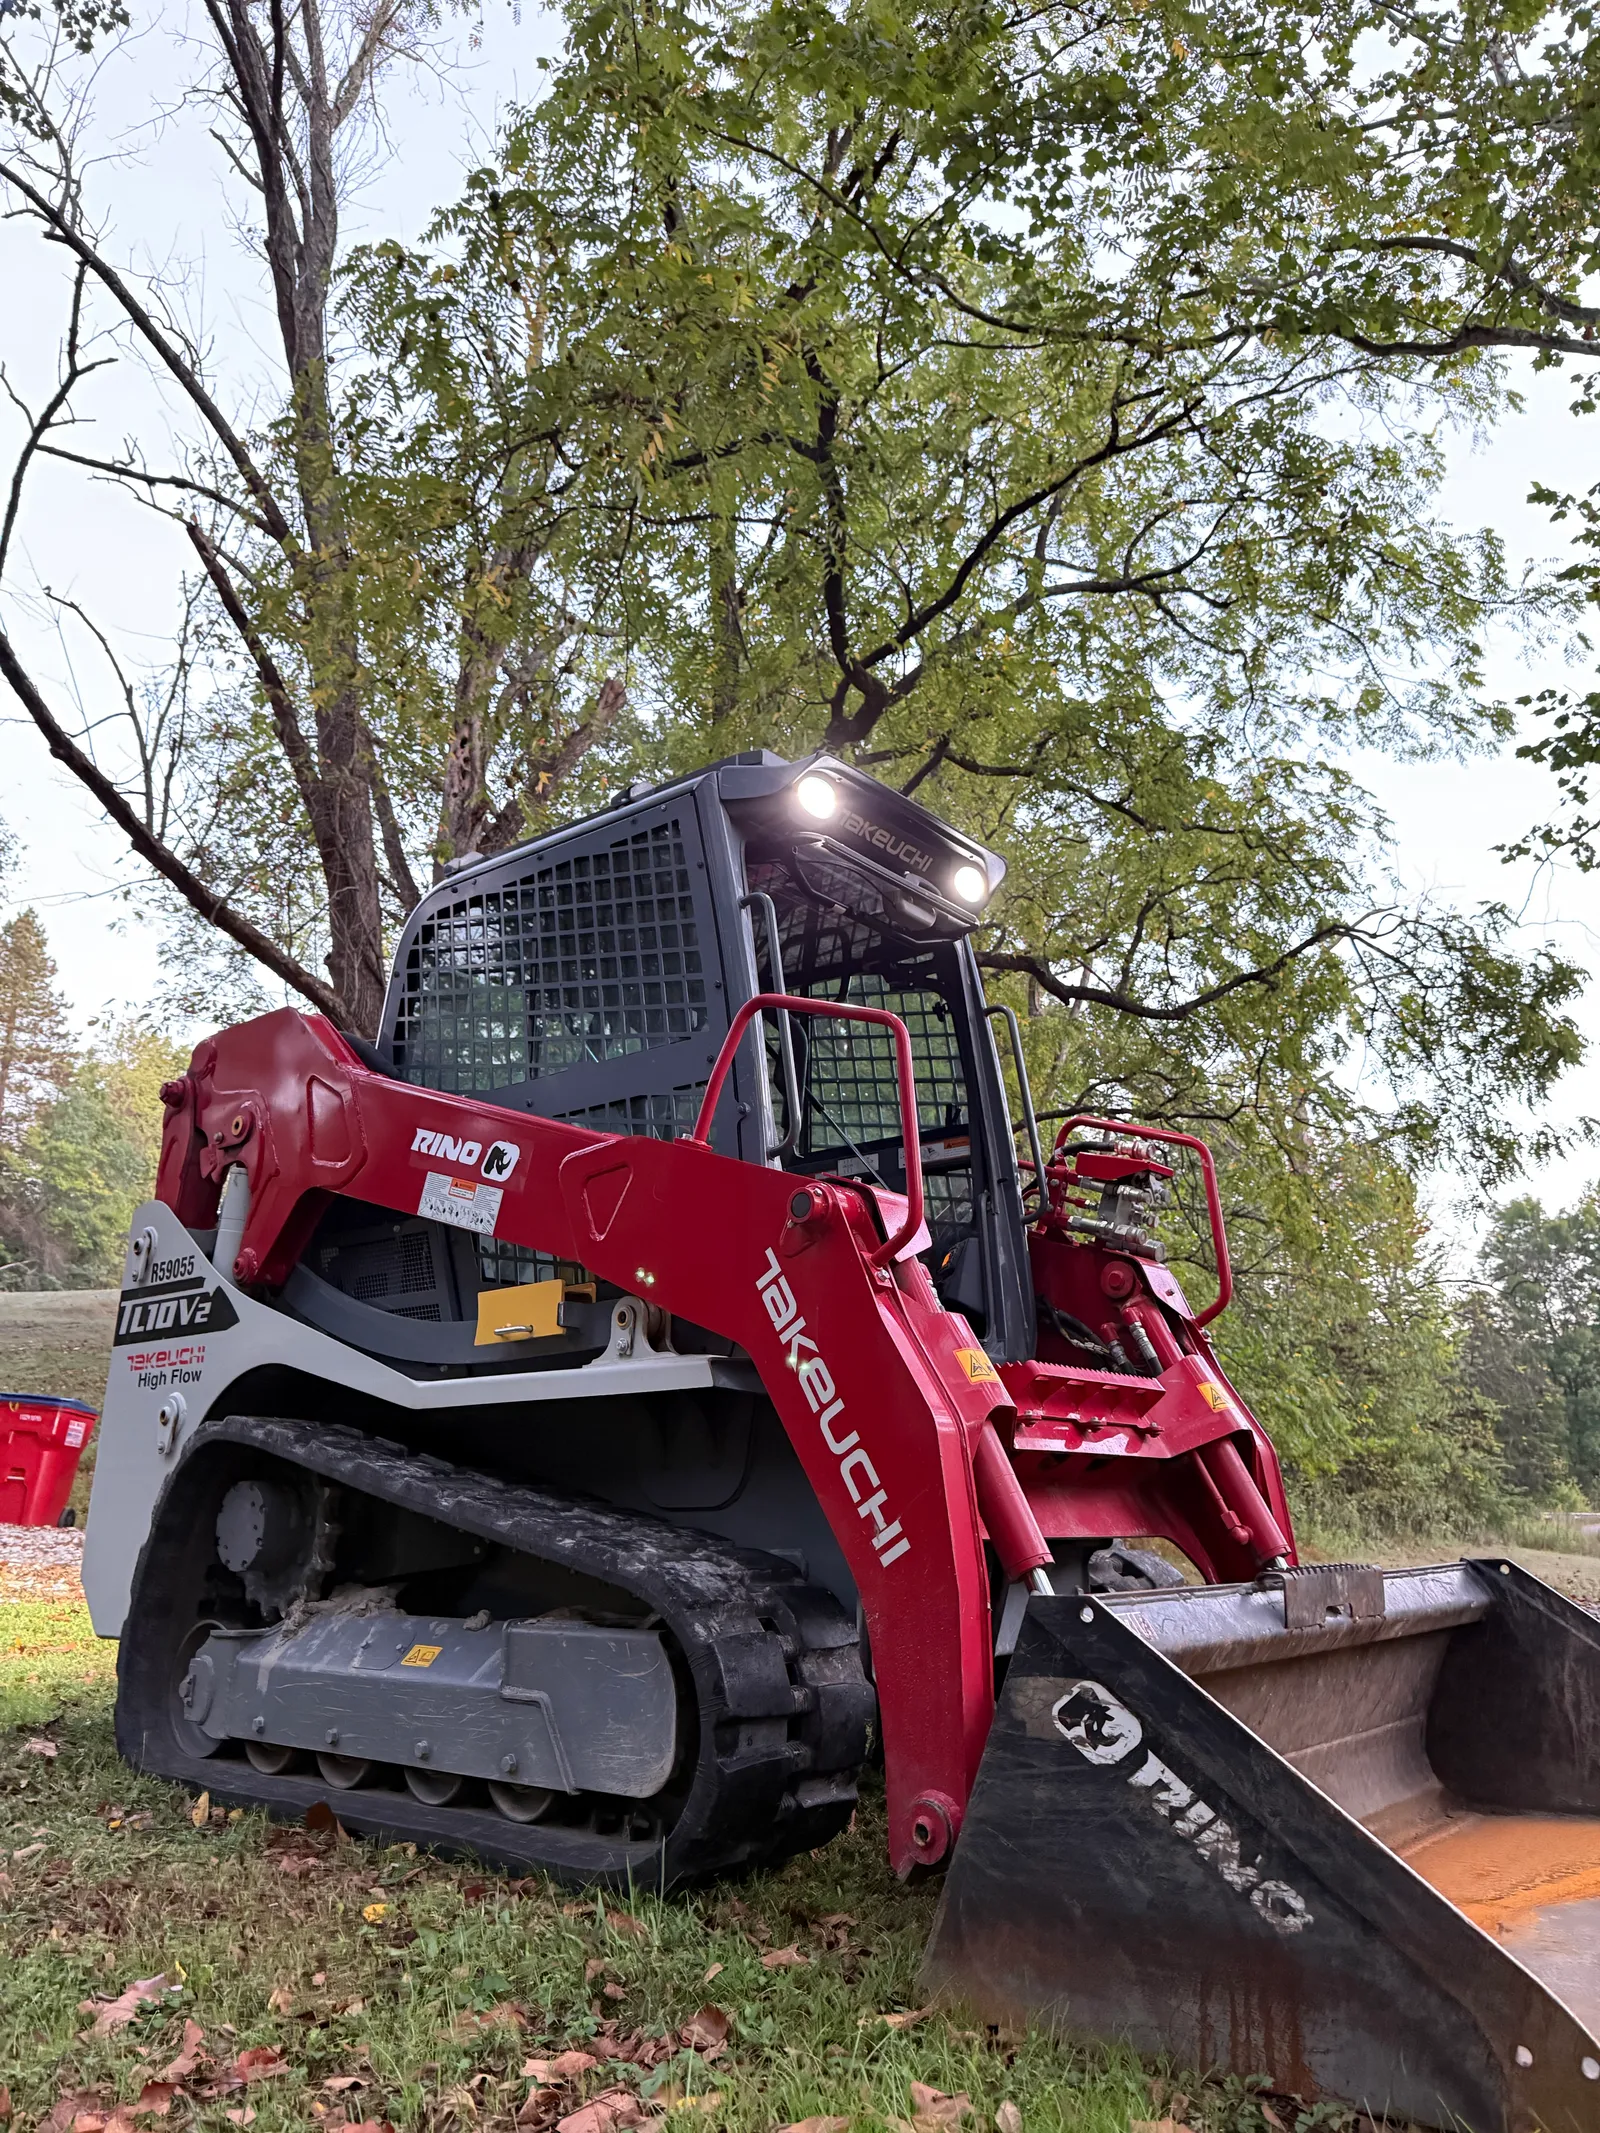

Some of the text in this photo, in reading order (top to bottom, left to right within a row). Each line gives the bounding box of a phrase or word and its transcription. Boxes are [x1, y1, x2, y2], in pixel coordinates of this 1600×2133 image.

[410, 1127, 483, 1166] RINO
[150, 1255, 195, 1283] R59055
[138, 1368, 202, 1390] High Flow
